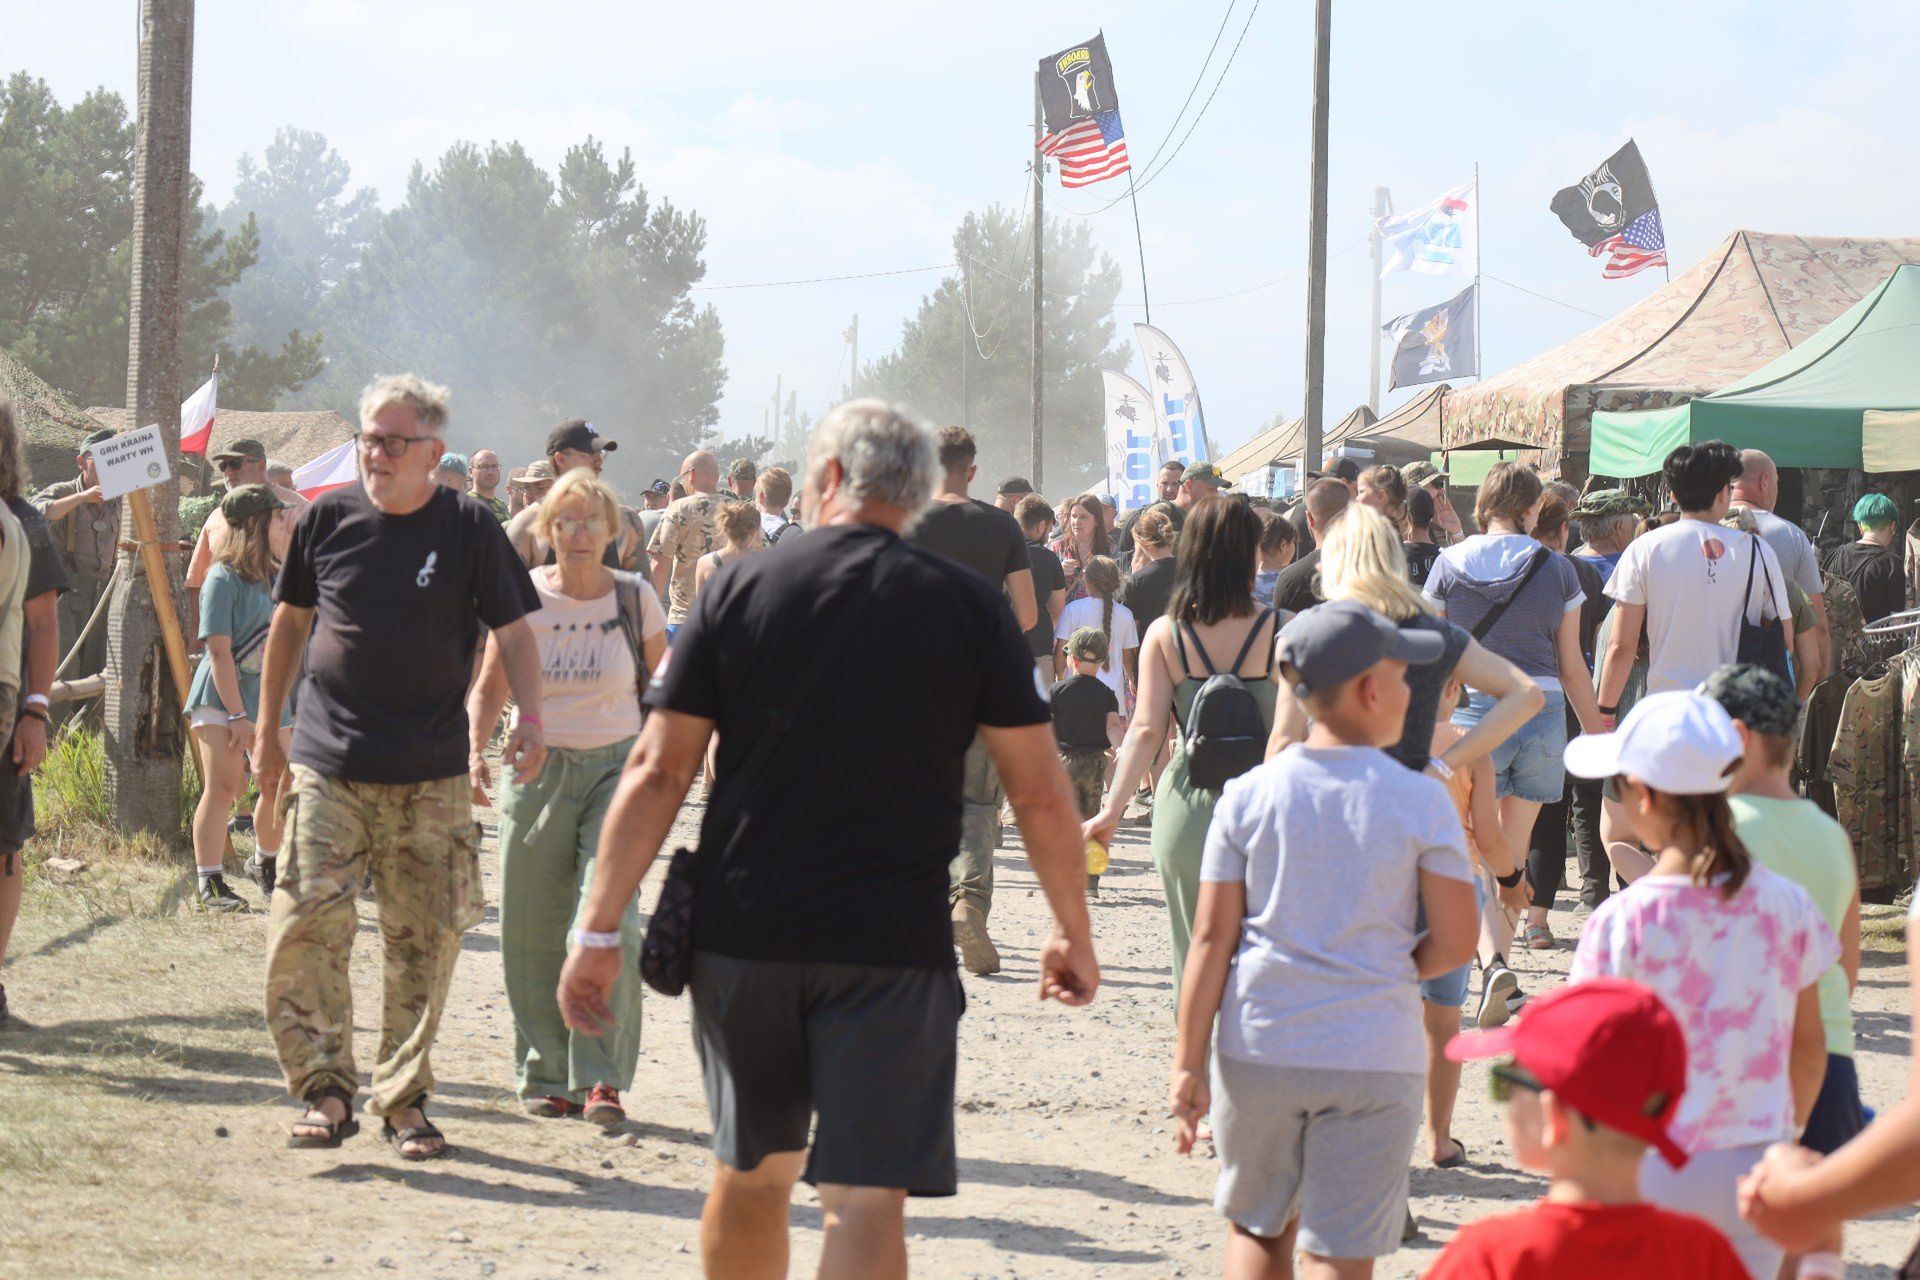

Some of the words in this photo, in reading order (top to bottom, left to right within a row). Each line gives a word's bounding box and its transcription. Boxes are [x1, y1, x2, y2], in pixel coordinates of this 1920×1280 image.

[99, 444, 119, 456] GRH
[120, 433, 154, 449] KRAINA
[106, 450, 137, 467] WARTY
[139, 446, 154, 456] WH
